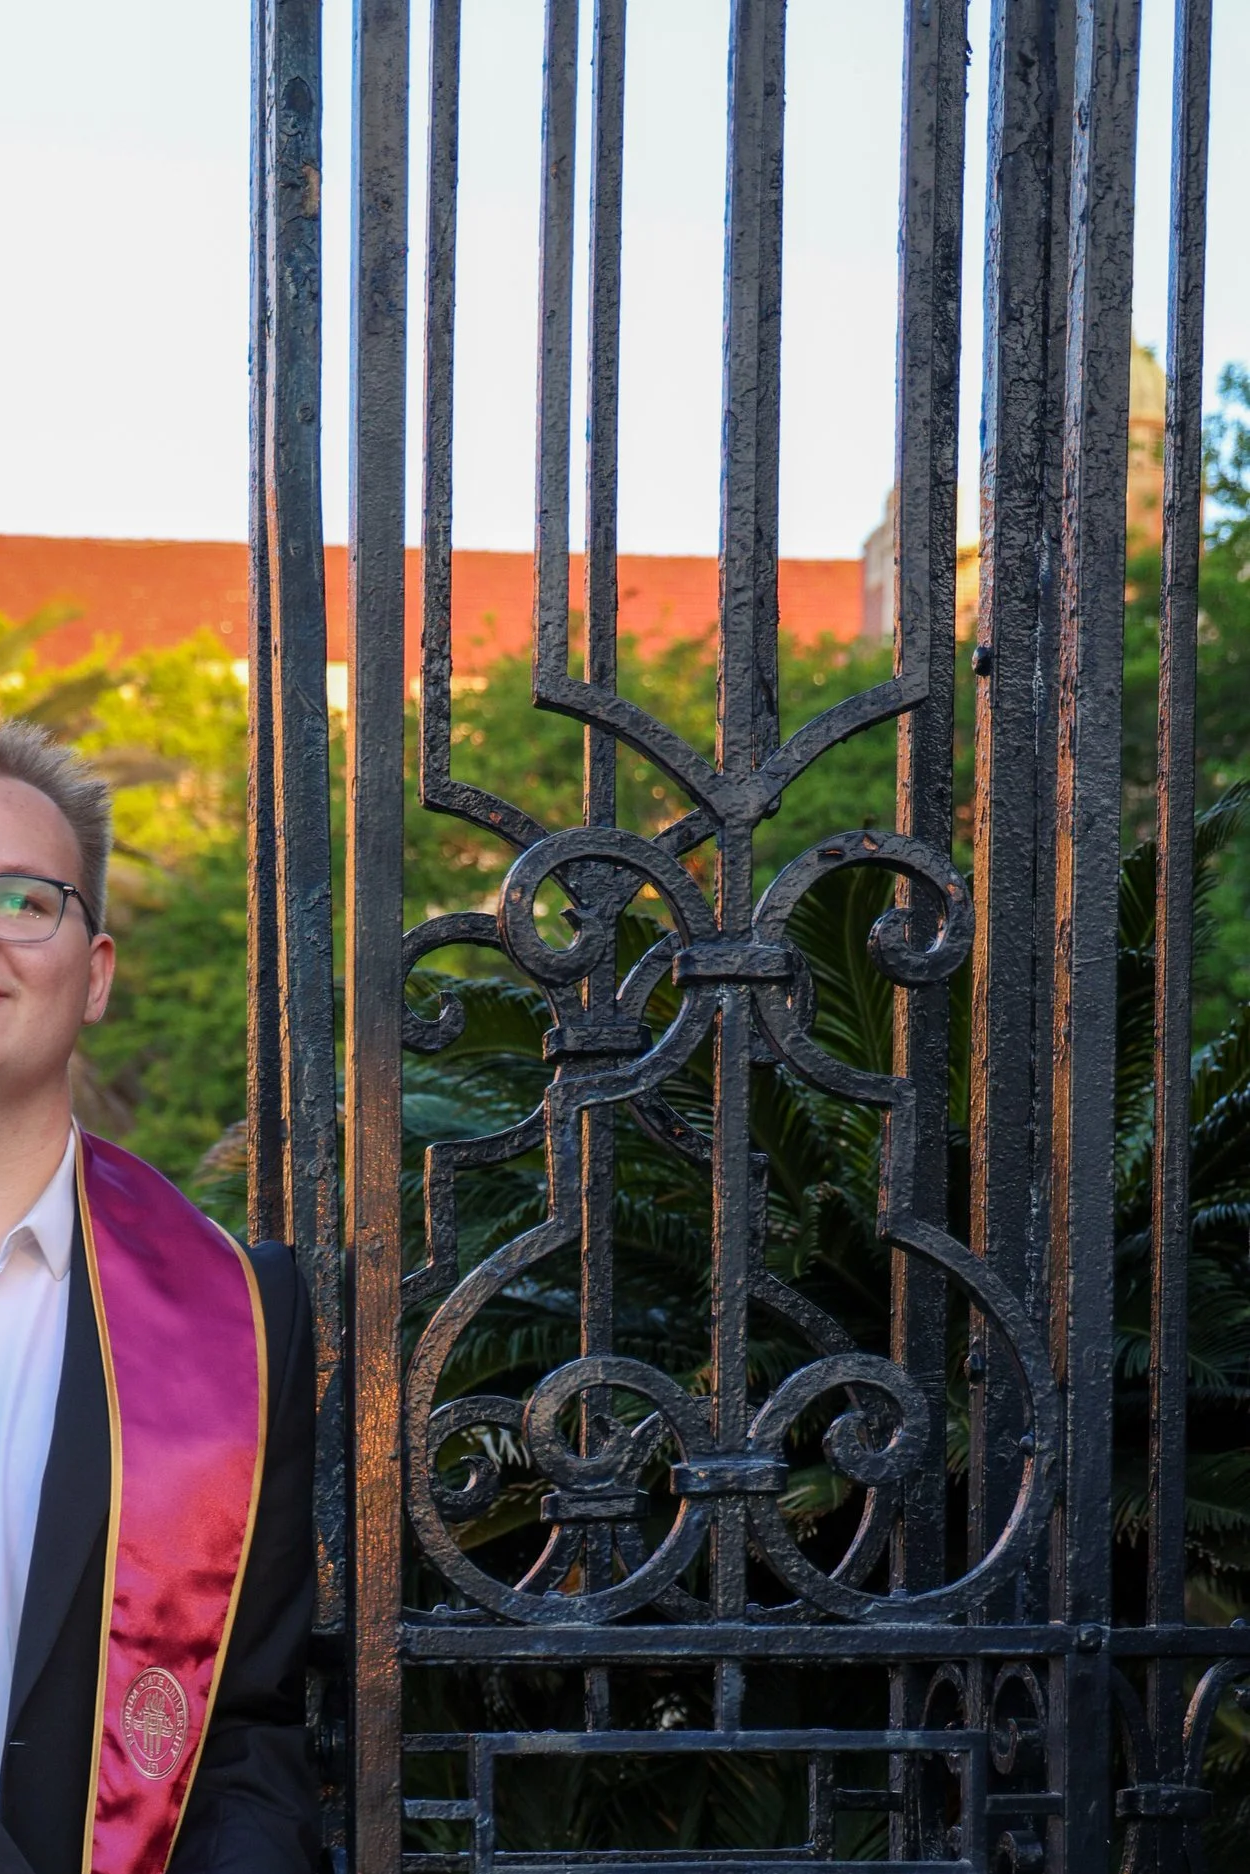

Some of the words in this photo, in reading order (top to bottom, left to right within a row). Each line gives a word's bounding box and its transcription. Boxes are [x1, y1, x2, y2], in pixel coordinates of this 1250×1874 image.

[124, 1688, 140, 1746] FLORIDA
[139, 1674, 165, 1687] STATE
[165, 1684, 184, 1759] UNIVERSITY
